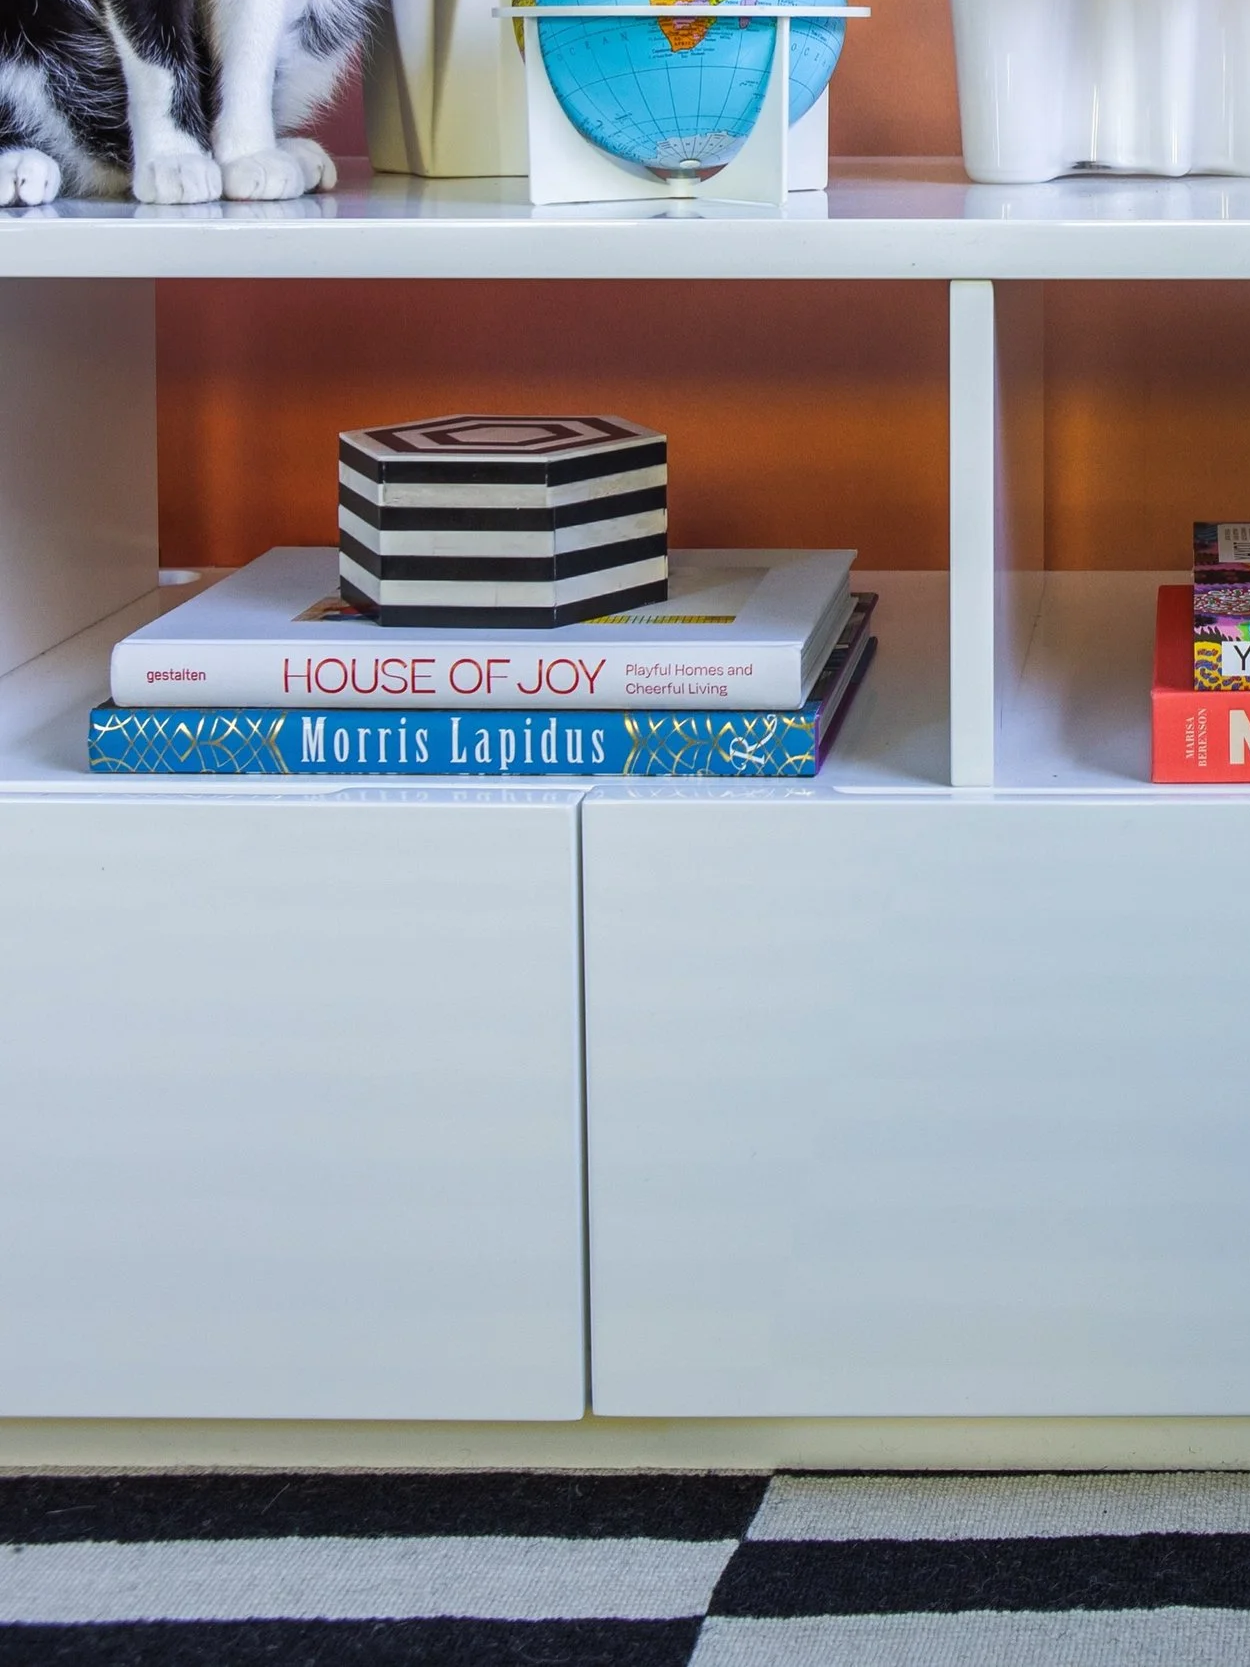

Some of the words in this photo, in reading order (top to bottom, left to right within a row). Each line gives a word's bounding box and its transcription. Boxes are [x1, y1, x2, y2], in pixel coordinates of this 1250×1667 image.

[146, 667, 207, 683] gestalten
[284, 658, 437, 694] HOUSE
[449, 658, 511, 694] OF
[516, 658, 607, 694] JOY
[625, 663, 672, 678] Playful
[675, 664, 724, 676] Homes
[727, 663, 754, 676] and
[625, 682, 685, 695] Cheerful
[688, 683, 728, 697] Living
[301, 716, 430, 764] Morris
[450, 716, 605, 771] Lapidus
[1185, 716, 1195, 759] MARISA
[1198, 708, 1208, 767] BERENSON
